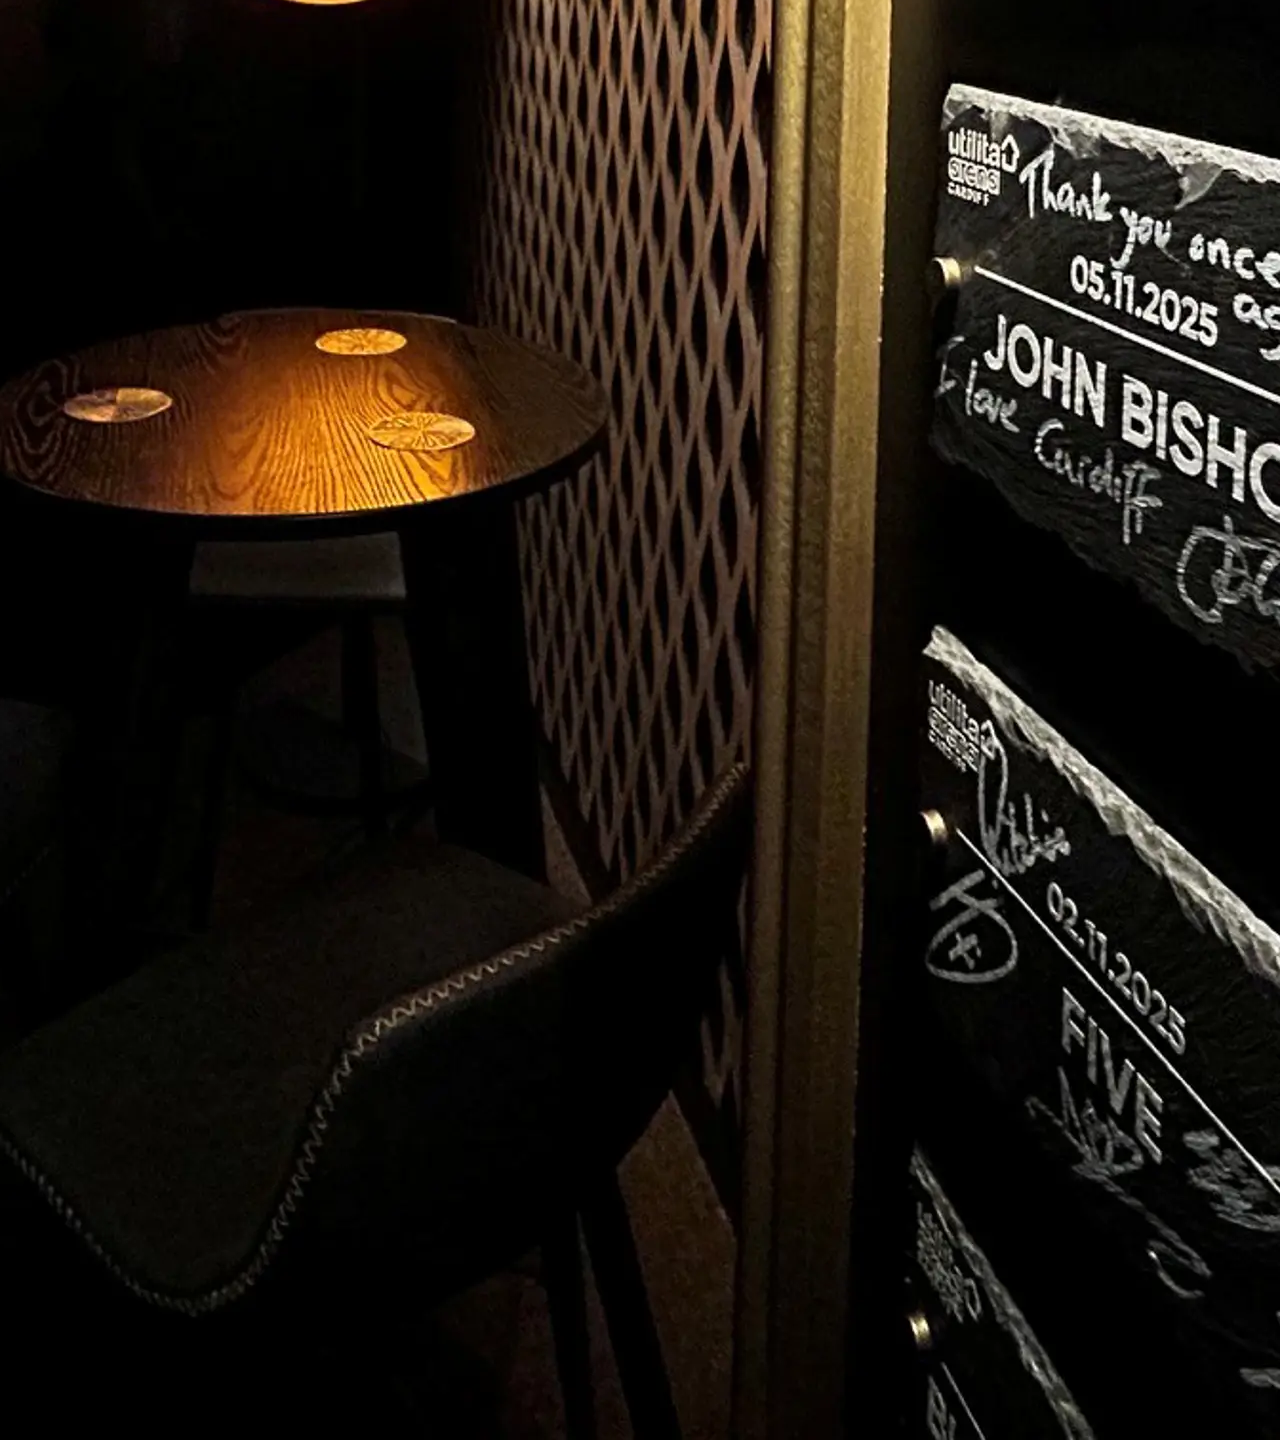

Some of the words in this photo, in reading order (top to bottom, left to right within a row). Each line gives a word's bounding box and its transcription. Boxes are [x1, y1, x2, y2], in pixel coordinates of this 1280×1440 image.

[947, 127, 1001, 169] utilita
[1019, 141, 1113, 221] Thank
[1109, 205, 1173, 271] you
[1069, 254, 1218, 348] 05.11.2025
[964, 358, 1020, 434] love
[982, 314, 1108, 430] JOHN
[1046, 882, 1187, 1058] 02.11.2025
[1060, 986, 1165, 1166] FIVE
